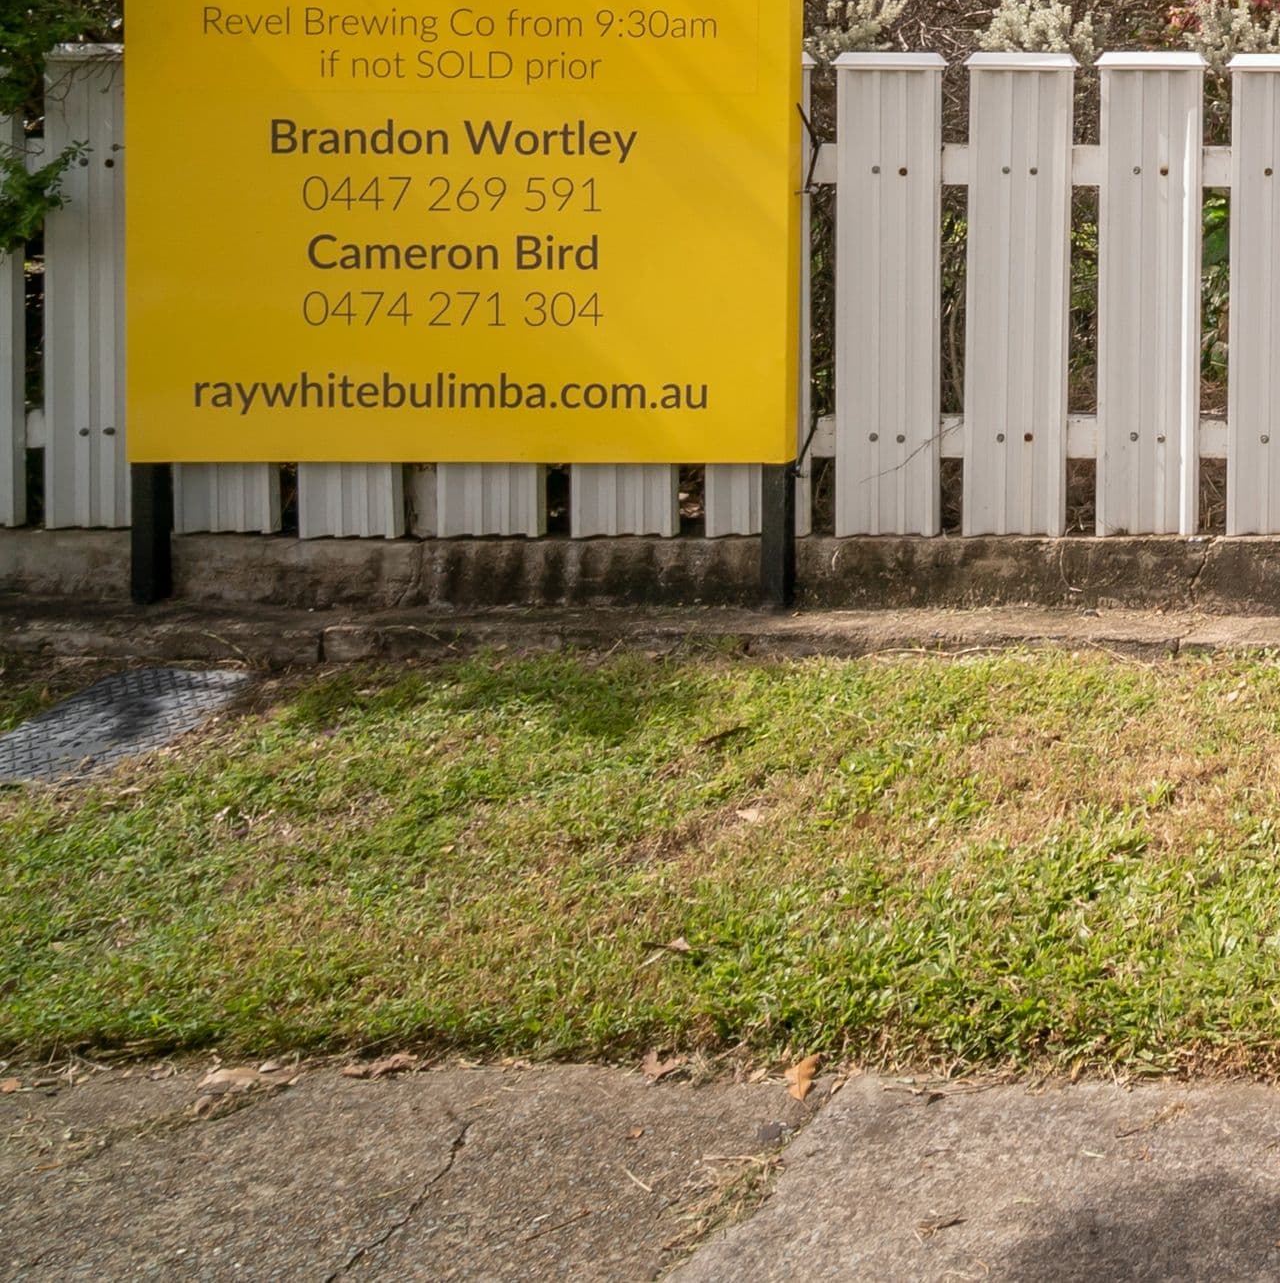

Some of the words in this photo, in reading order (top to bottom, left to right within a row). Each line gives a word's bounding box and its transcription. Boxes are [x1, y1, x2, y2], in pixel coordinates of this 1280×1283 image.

[202, 6, 291, 36] Revel
[304, 6, 440, 44] Brewing
[449, 7, 496, 38] Co
[506, 7, 584, 38] from
[595, 9, 718, 40] 9:30am
[318, 49, 340, 79] if
[350, 52, 406, 79] not
[416, 49, 515, 80] SOLD
[526, 51, 603, 86] prior
[270, 118, 449, 156] Brandon
[463, 119, 638, 165] Wortley
[301, 175, 413, 213] 0447
[427, 176, 508, 213] 269
[524, 176, 602, 214] 591
[307, 233, 499, 272] Cameron
[515, 233, 599, 272] Bird
[302, 290, 414, 327] 0474
[428, 291, 507, 328] 271
[523, 291, 604, 328] 304
[194, 371, 708, 416] raywhitebulimba.com.au
